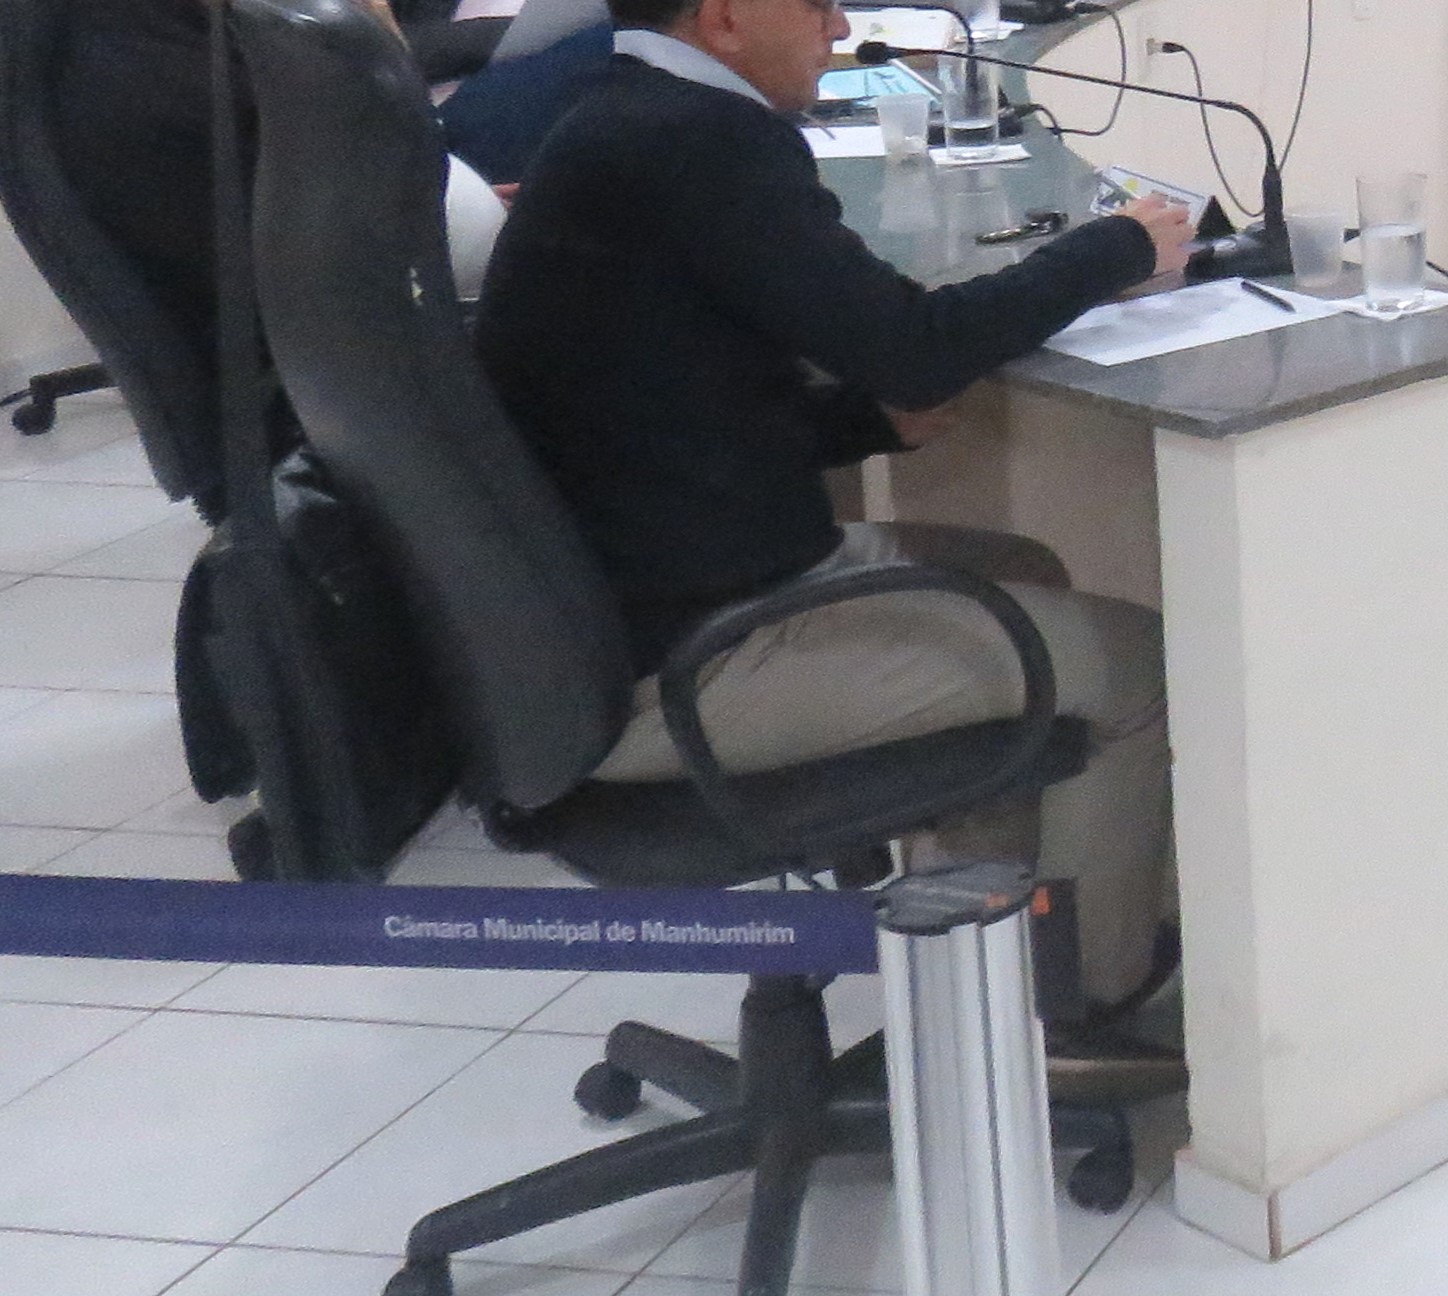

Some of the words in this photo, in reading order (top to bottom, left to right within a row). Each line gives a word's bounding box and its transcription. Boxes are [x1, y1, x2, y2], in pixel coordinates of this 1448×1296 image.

[383, 915, 477, 940] Câmara
[484, 917, 600, 945] Municipal
[606, 919, 635, 943] de
[641, 920, 795, 945] Manhumirim
